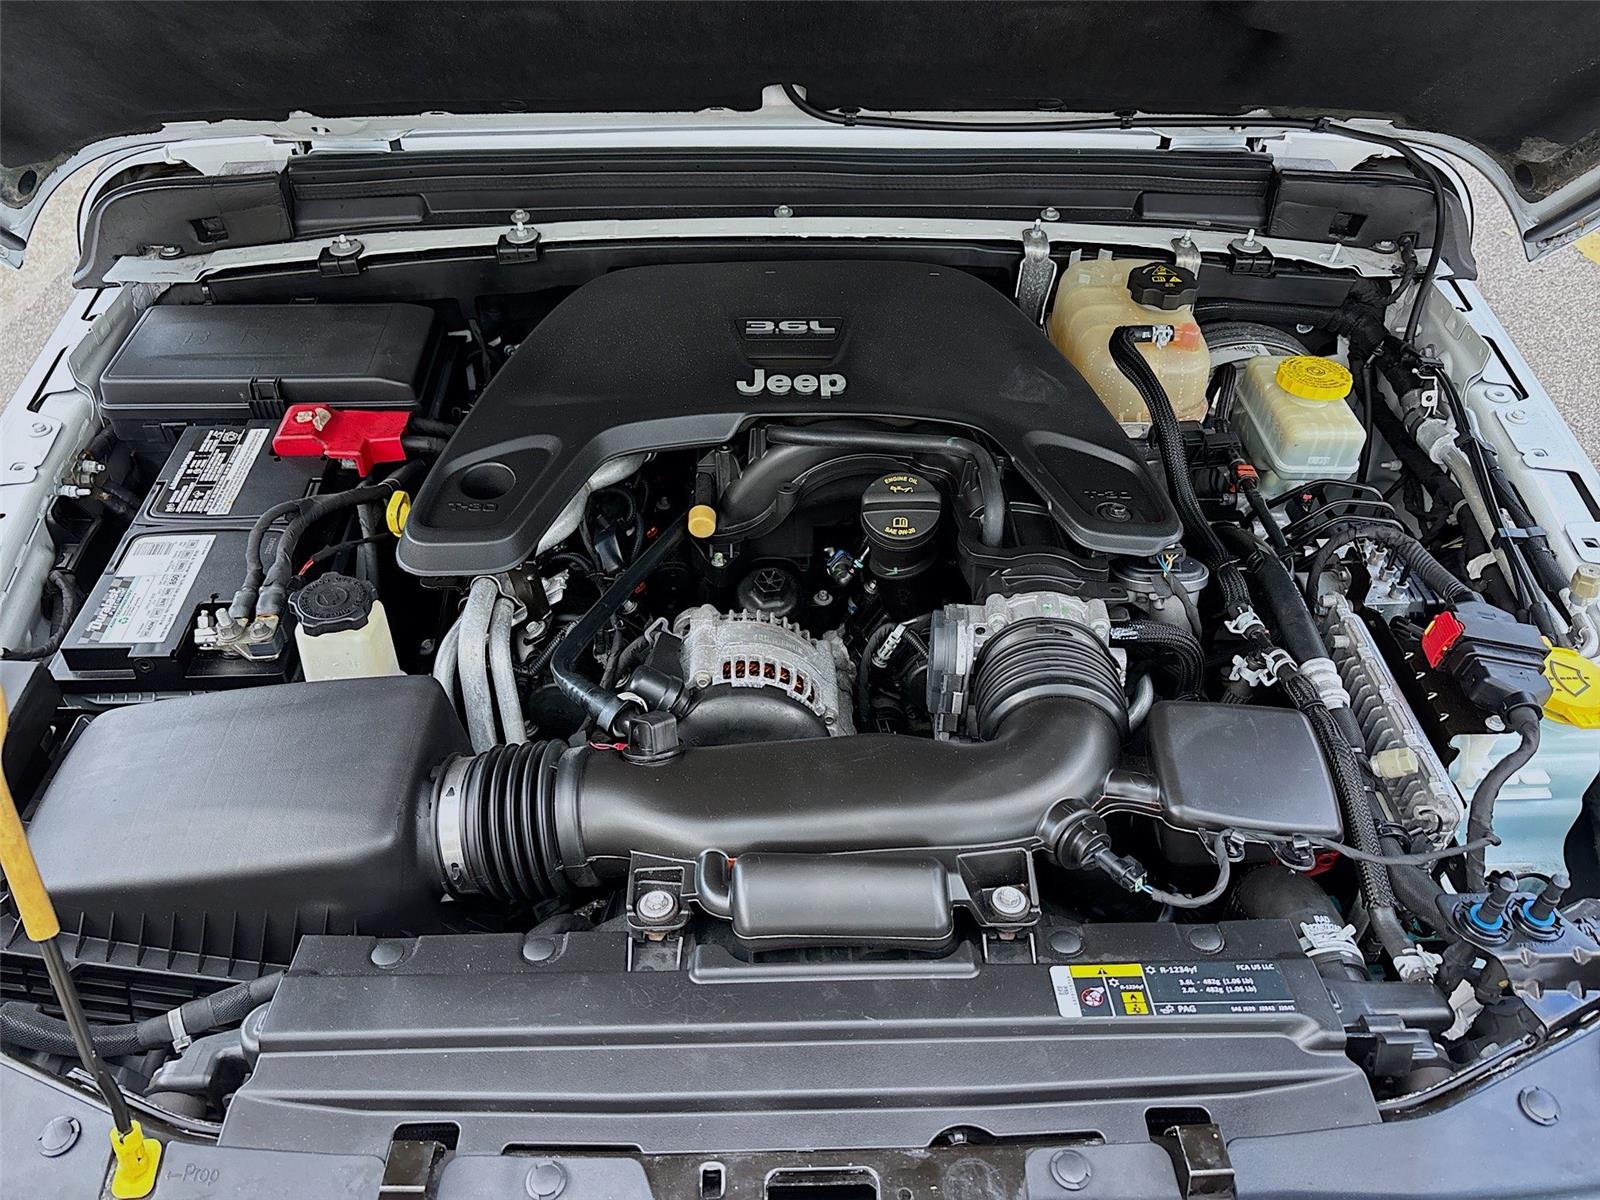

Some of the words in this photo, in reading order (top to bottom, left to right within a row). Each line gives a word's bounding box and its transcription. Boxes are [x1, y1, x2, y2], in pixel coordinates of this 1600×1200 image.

[746, 321, 835, 334] 3.6L
[736, 369, 847, 399] Jeep
[884, 476, 908, 484] ENGINE
[908, 477, 918, 485] OIL
[884, 526, 897, 535] SAE
[86, 588, 121, 631] Duralast
[1313, 915, 1331, 923] RAD
[1159, 965, 1198, 975] R-1234yf
[1250, 963, 1262, 971] US
[1177, 1005, 1197, 1013] PAG
[182, 1163, 220, 1187] Prop
